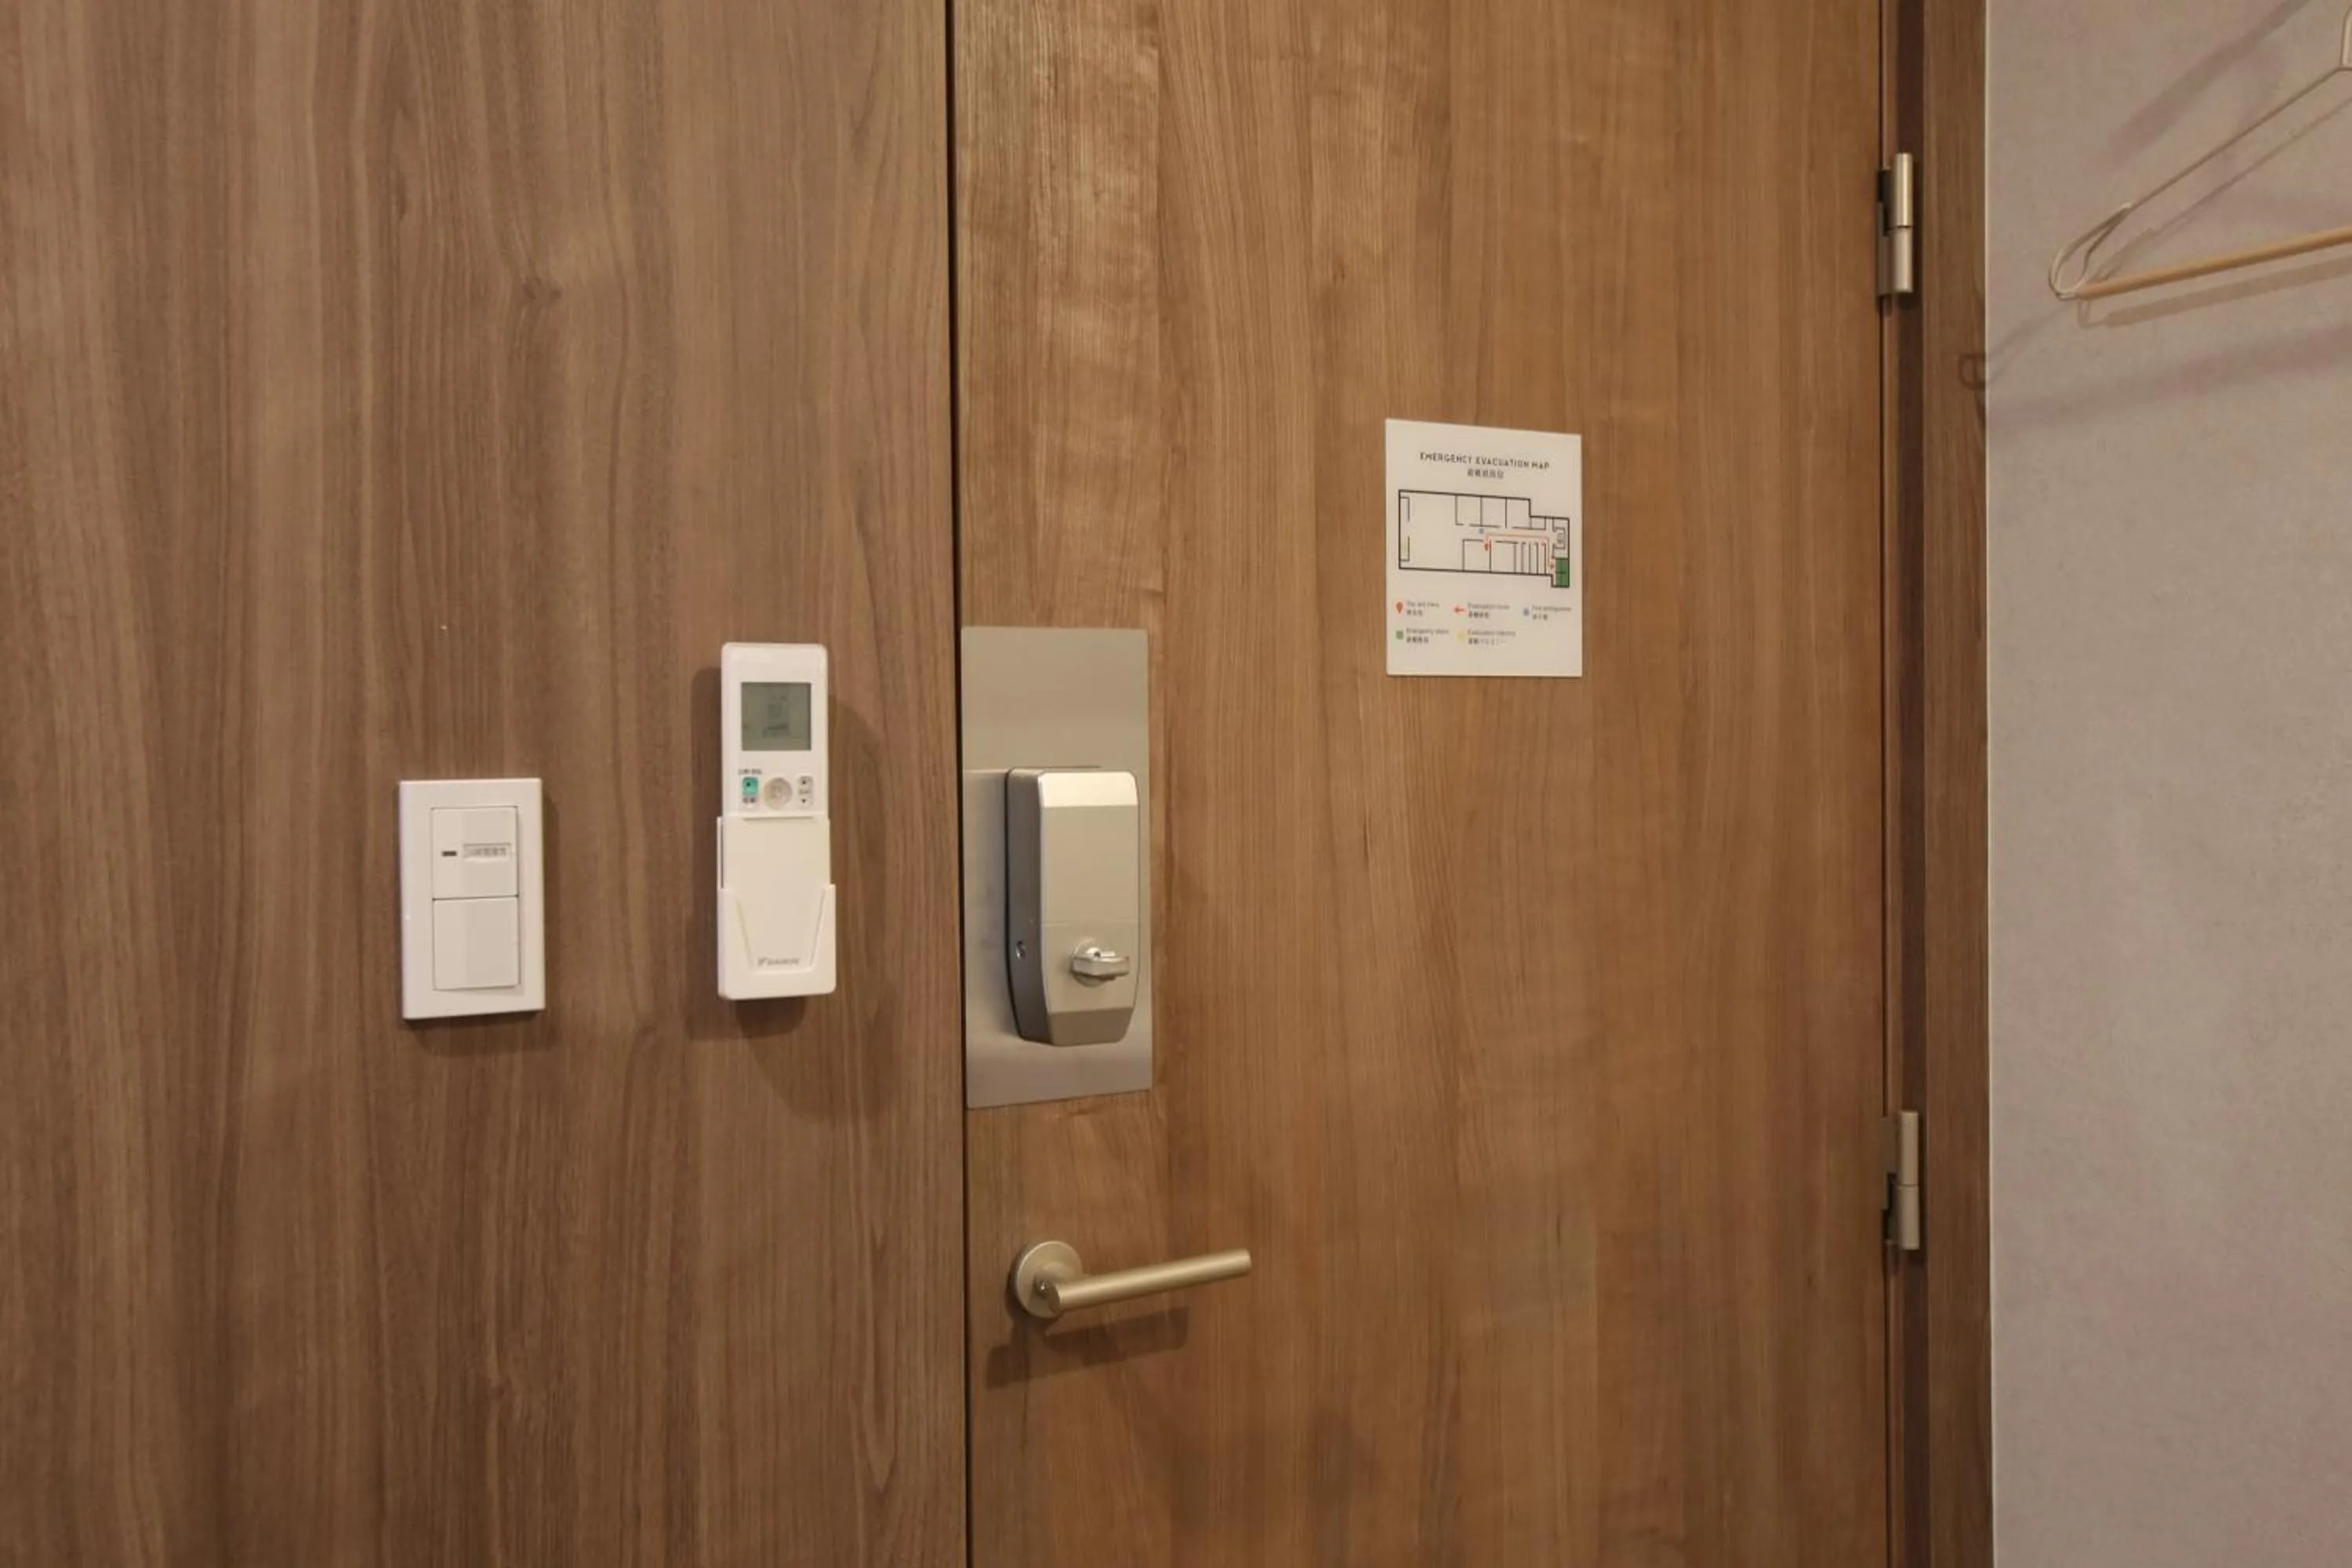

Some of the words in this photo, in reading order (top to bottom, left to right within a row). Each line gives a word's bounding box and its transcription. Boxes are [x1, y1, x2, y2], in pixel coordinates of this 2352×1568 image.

[1420, 452, 1472, 464] EMERGENCY
[1475, 456, 1530, 469] EVACUATION
[1532, 460, 1550, 470] MAP
